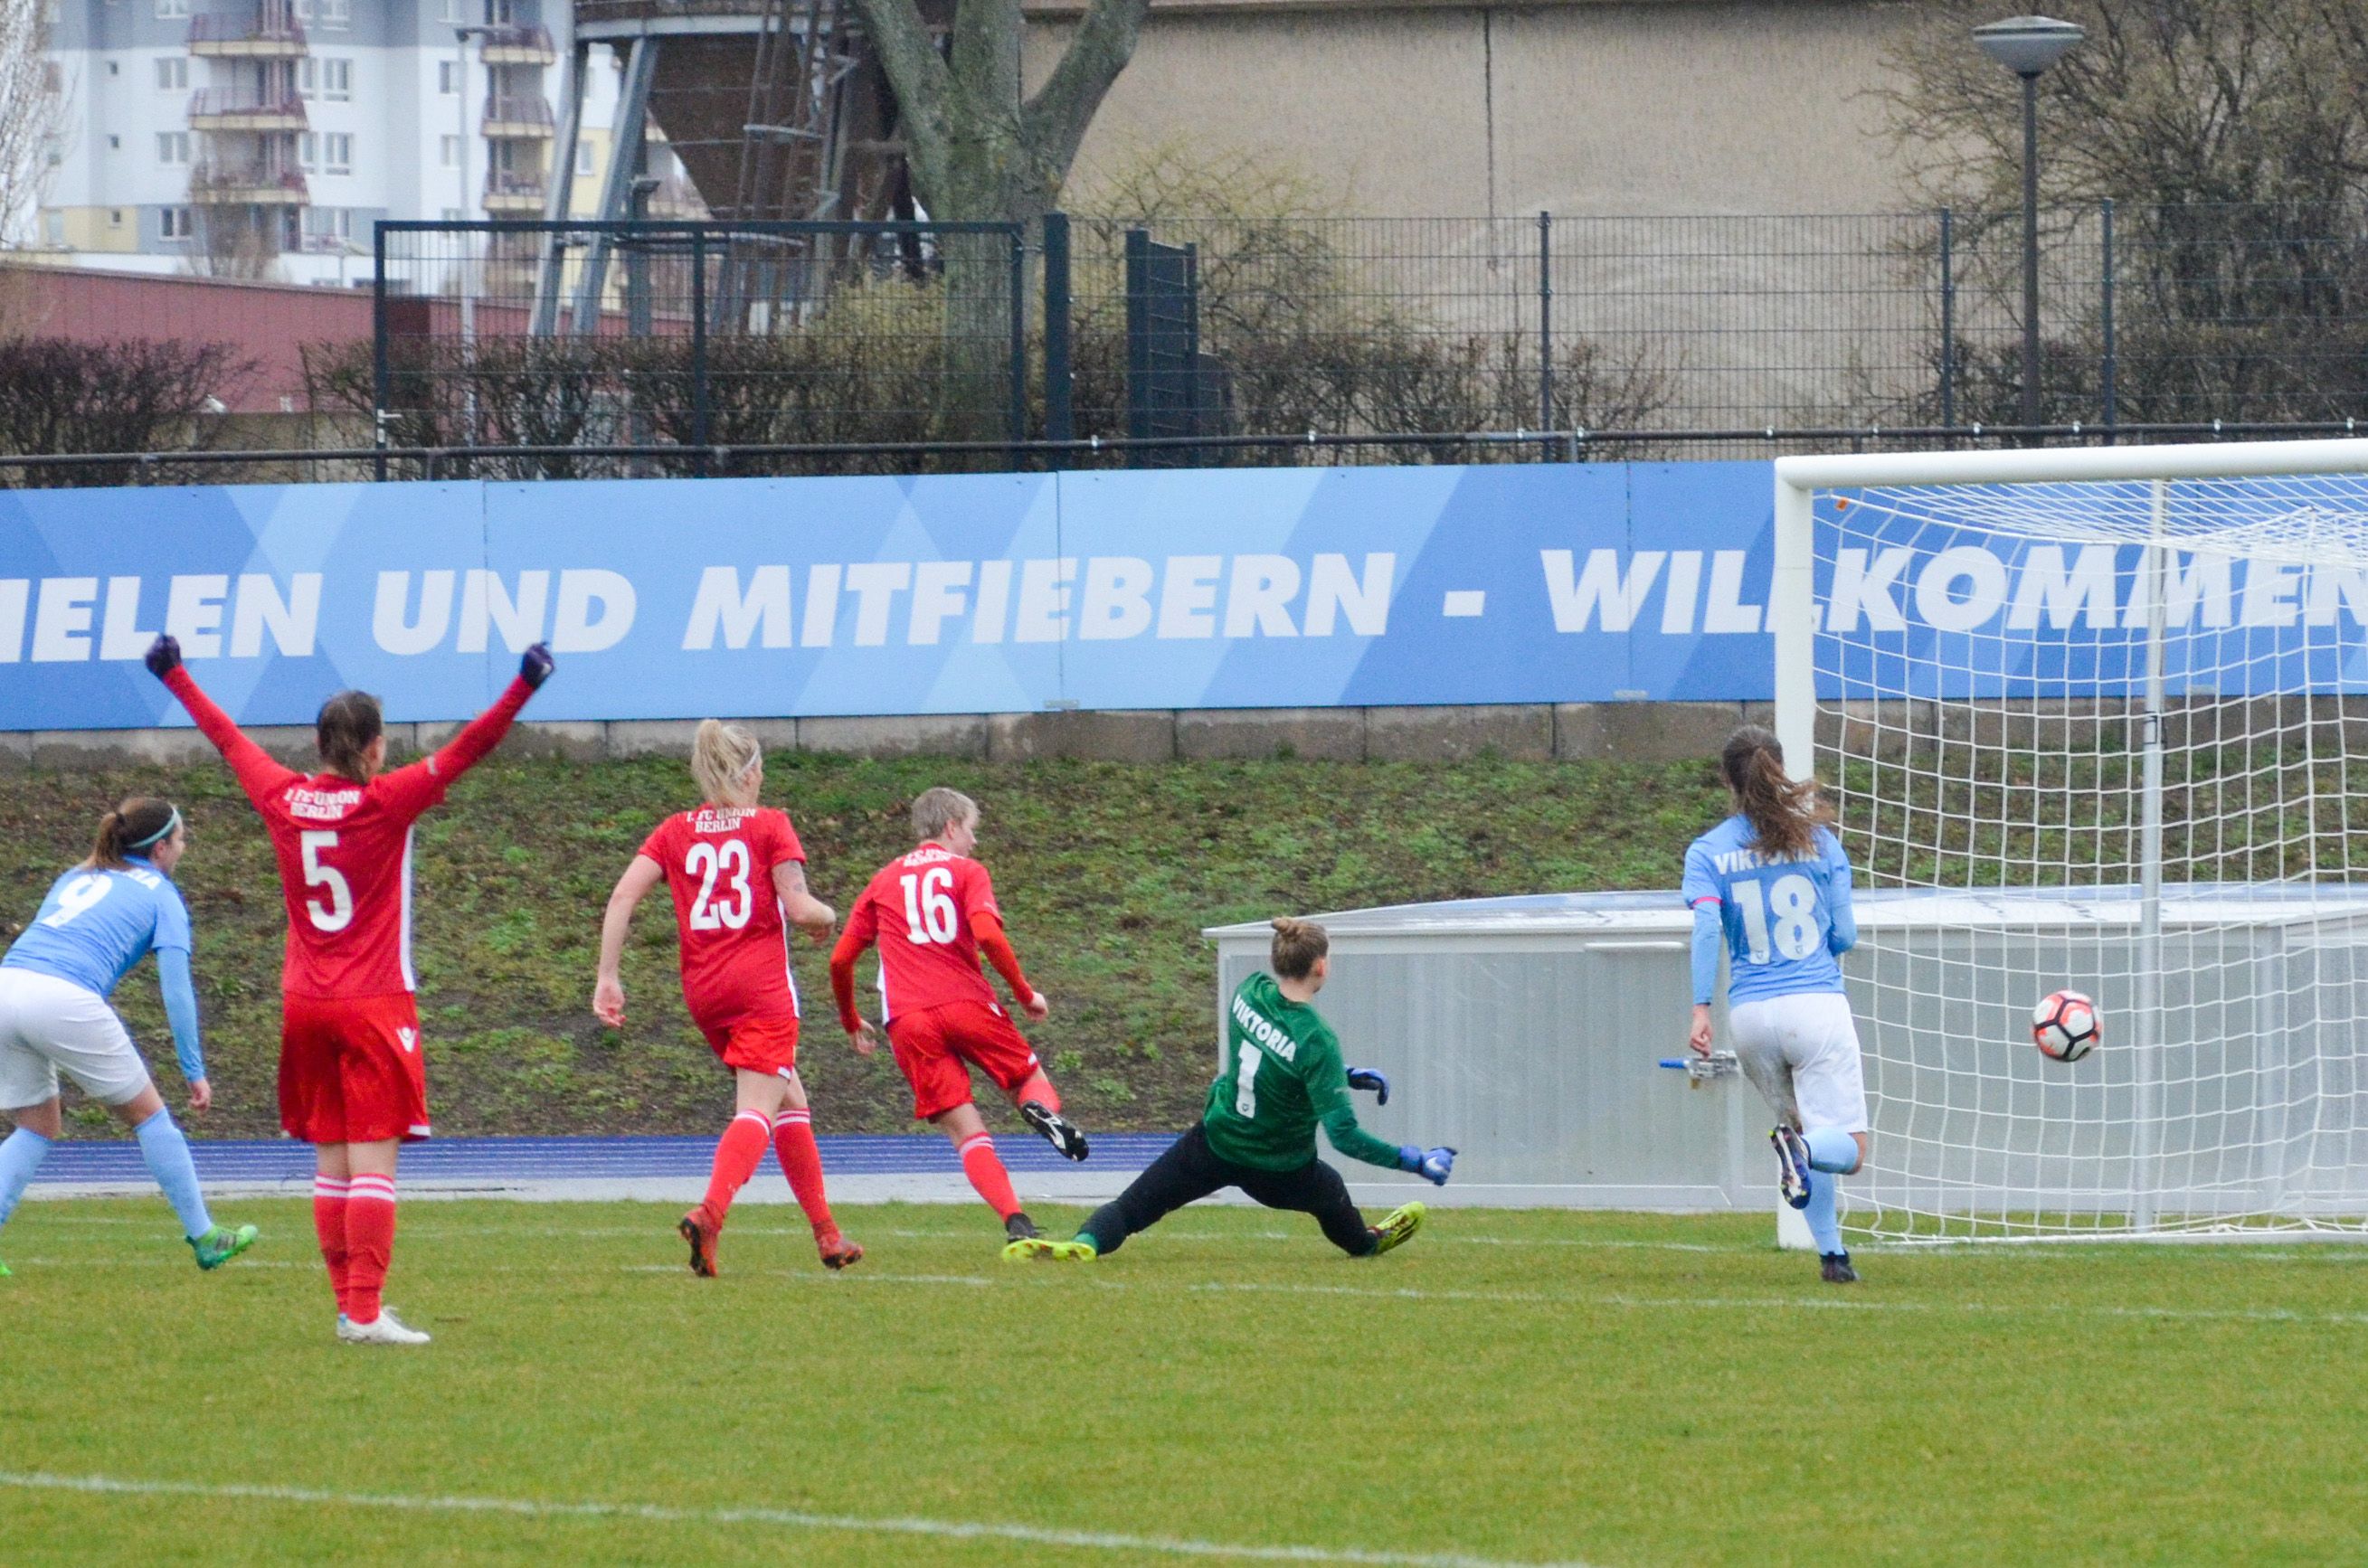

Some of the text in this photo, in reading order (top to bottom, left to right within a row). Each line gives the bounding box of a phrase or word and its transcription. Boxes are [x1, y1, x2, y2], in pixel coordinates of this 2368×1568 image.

[372, 569, 637, 655] UND
[681, 553, 1396, 650] MITFIEBERN
[1443, 590, 1485, 617] -
[290, 801, 344, 819] BERLIN
[695, 817, 742, 833] BERLIN
[697, 810, 714, 821] FC
[42, 874, 113, 929] 9
[300, 830, 353, 932] 5
[686, 839, 752, 930] 23
[900, 867, 957, 945] 16
[1730, 874, 1820, 965] 18
[1232, 994, 1296, 1063] VIKTORIA
[1236, 1039, 1263, 1119] 1
